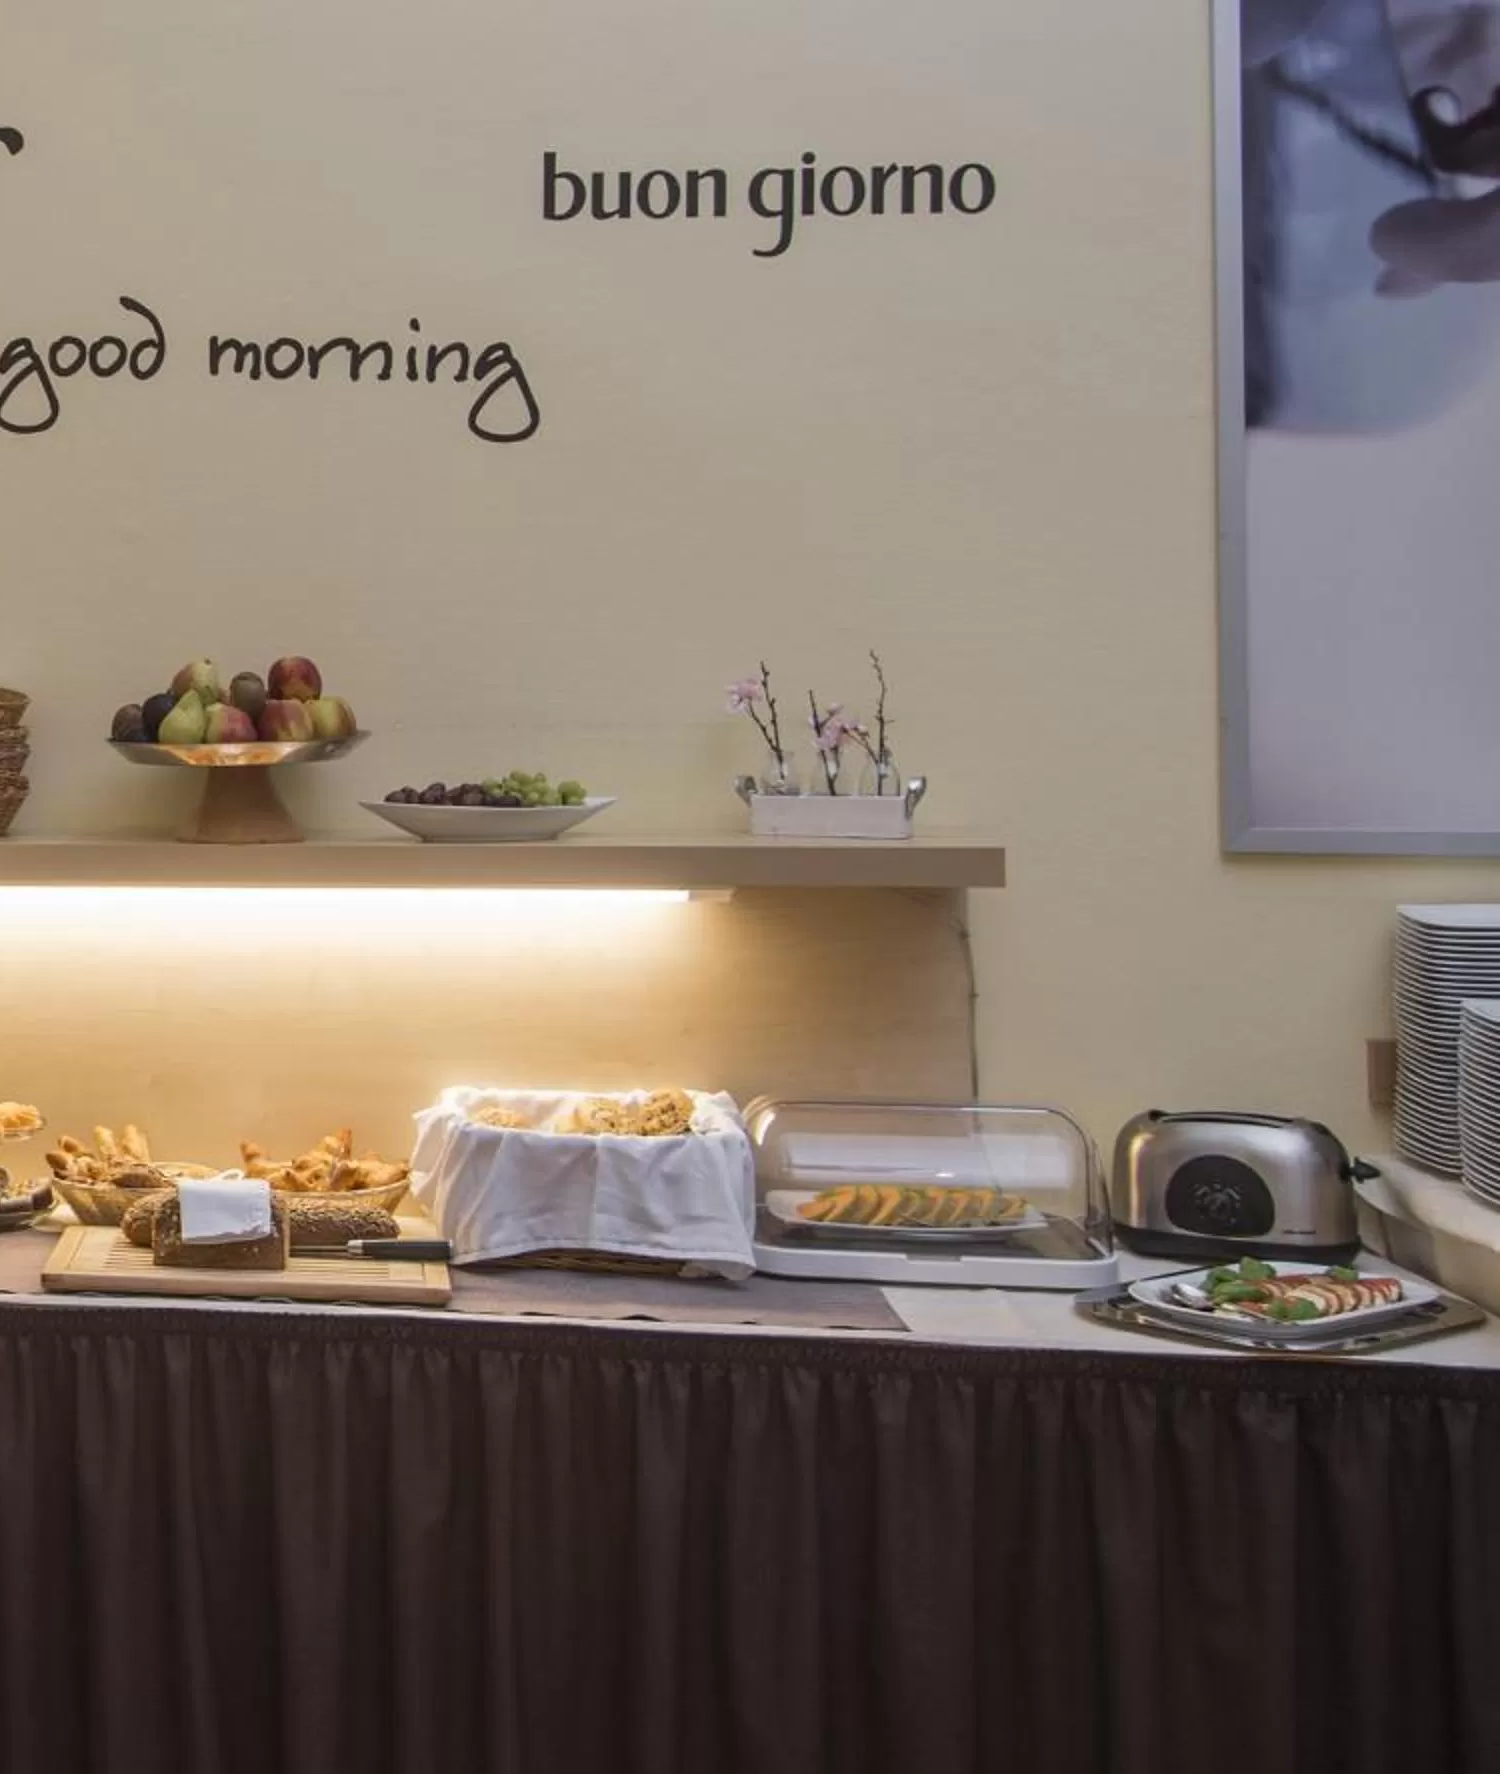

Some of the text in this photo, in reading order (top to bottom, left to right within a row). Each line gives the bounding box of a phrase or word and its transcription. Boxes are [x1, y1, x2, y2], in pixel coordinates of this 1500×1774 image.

[542, 151, 996, 258] buon giorno
[208, 317, 542, 445] morning
